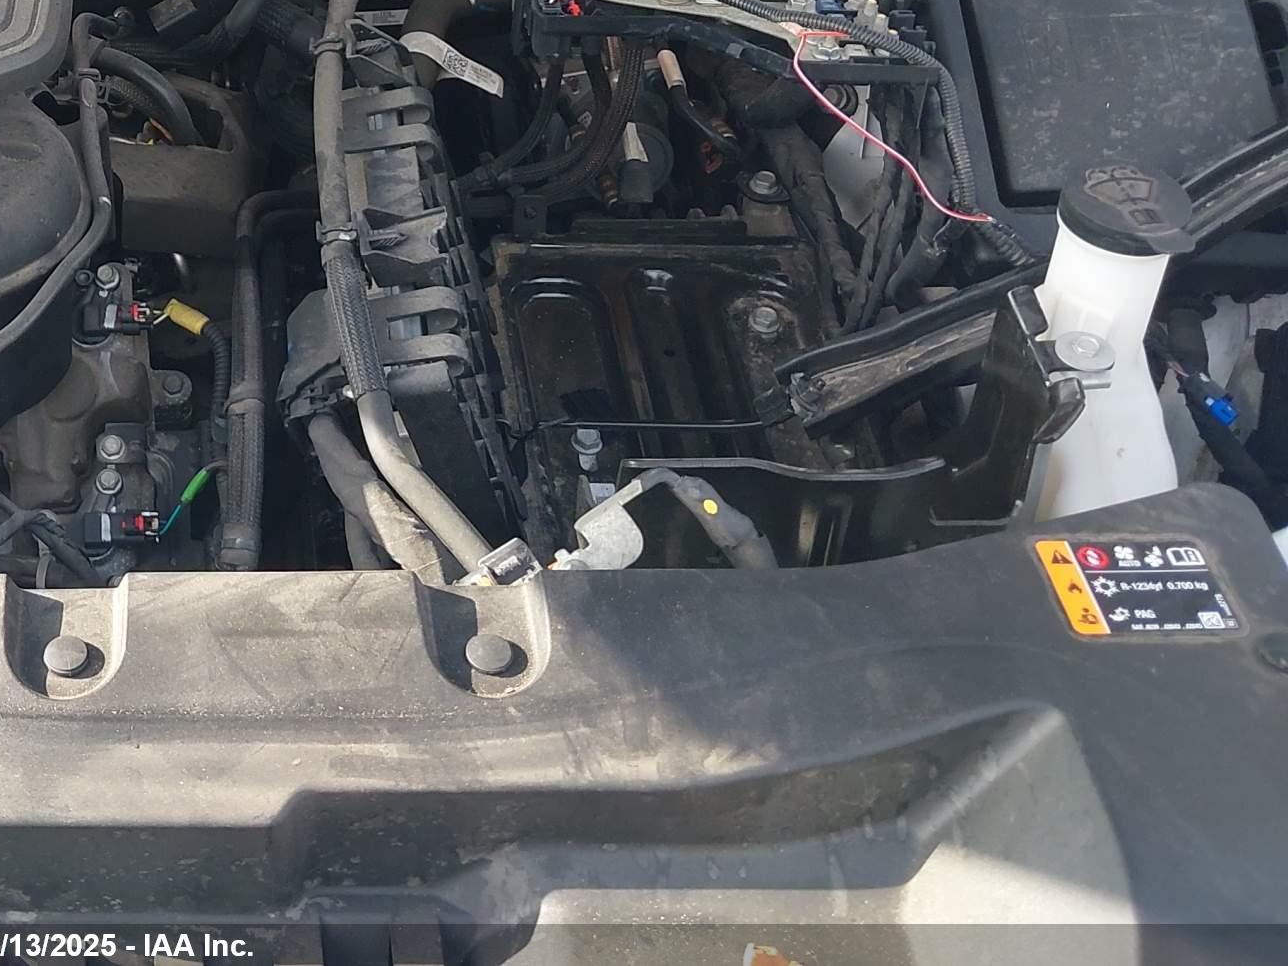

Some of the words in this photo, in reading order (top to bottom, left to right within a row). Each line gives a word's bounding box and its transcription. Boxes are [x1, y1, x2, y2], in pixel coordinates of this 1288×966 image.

[1166, 581, 1194, 590] 0.700
[1194, 581, 1209, 591] kg
[1134, 609, 1157, 619] PAG
